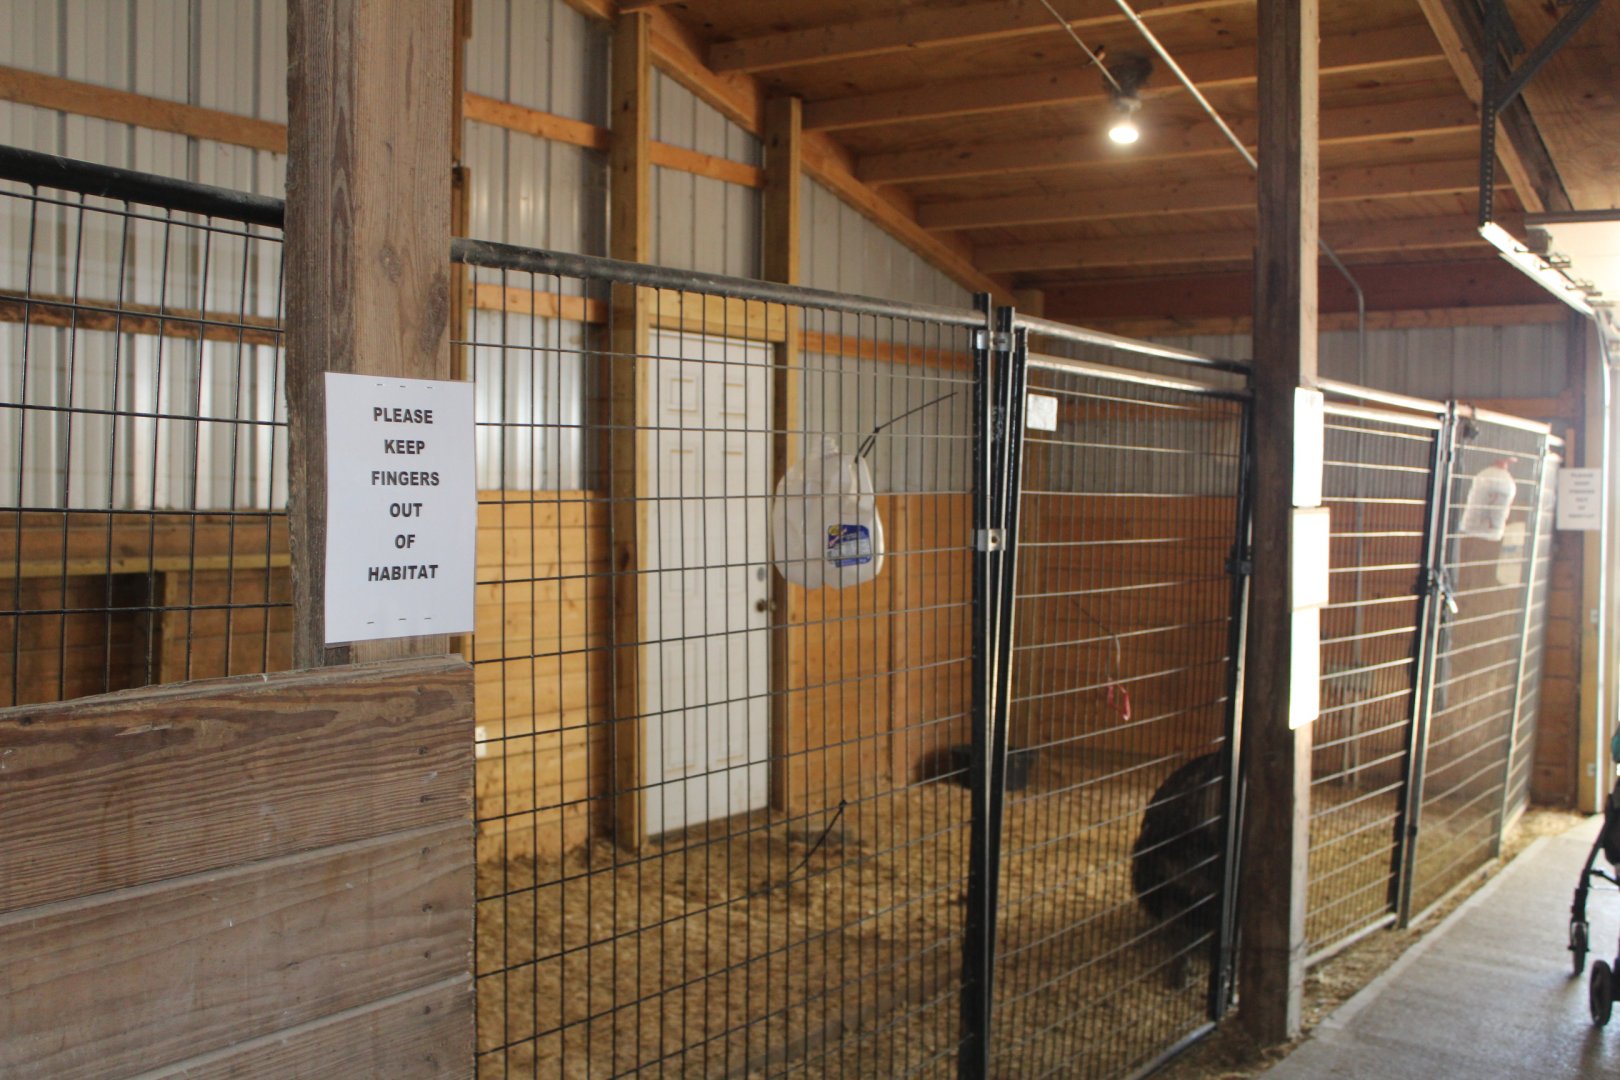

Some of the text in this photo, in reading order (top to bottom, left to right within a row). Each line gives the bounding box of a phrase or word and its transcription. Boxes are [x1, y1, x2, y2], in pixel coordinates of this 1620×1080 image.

[374, 407, 433, 424] PLEASE
[385, 440, 425, 454] KEEP
[372, 471, 438, 486] FINGERS
[390, 503, 422, 517] OUT
[395, 535, 415, 548] OF
[369, 565, 438, 581] HABITAT
